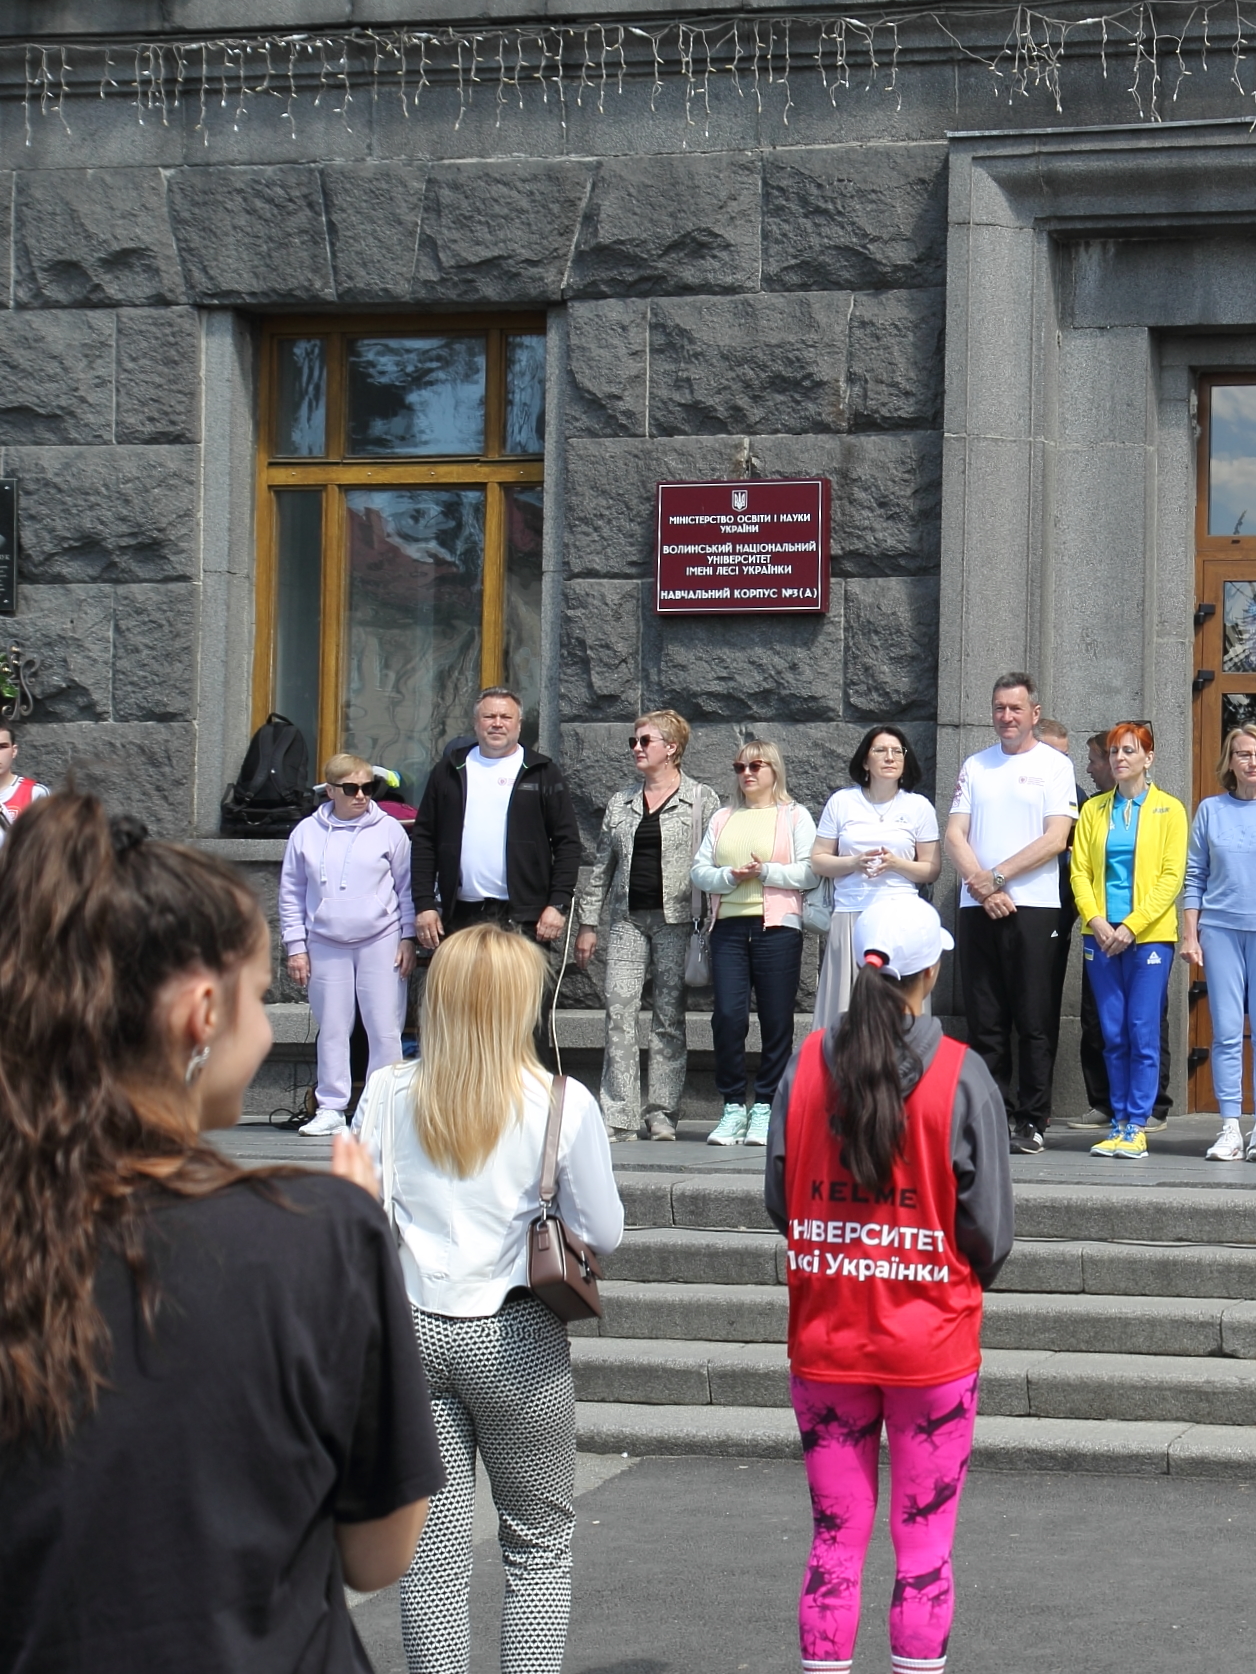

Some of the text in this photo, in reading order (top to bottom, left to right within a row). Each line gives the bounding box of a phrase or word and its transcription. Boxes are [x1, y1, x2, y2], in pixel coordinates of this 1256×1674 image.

[669, 513, 811, 525] МІНІСТЕРСТВО ОСВІТИ І НАУКИ
[720, 524, 759, 533] УКРАЇНИ
[663, 541, 817, 554] ВОЛИНСЬКИЙ НАЦІОНАЛЬНИЙ
[707, 555, 771, 565] УНІВЕРСИТЕТ
[686, 564, 792, 576] ІМЕНІ ЛЕСІ УКРАЇНКИ
[661, 588, 730, 600] НАВЧАЛЬНИЙ
[734, 588, 778, 598] КОРПУС
[811, 1180, 917, 1209] KELME
[789, 1219, 945, 1253] НІВЕРСИТЕТ
[825, 1252, 949, 1282] Українки
